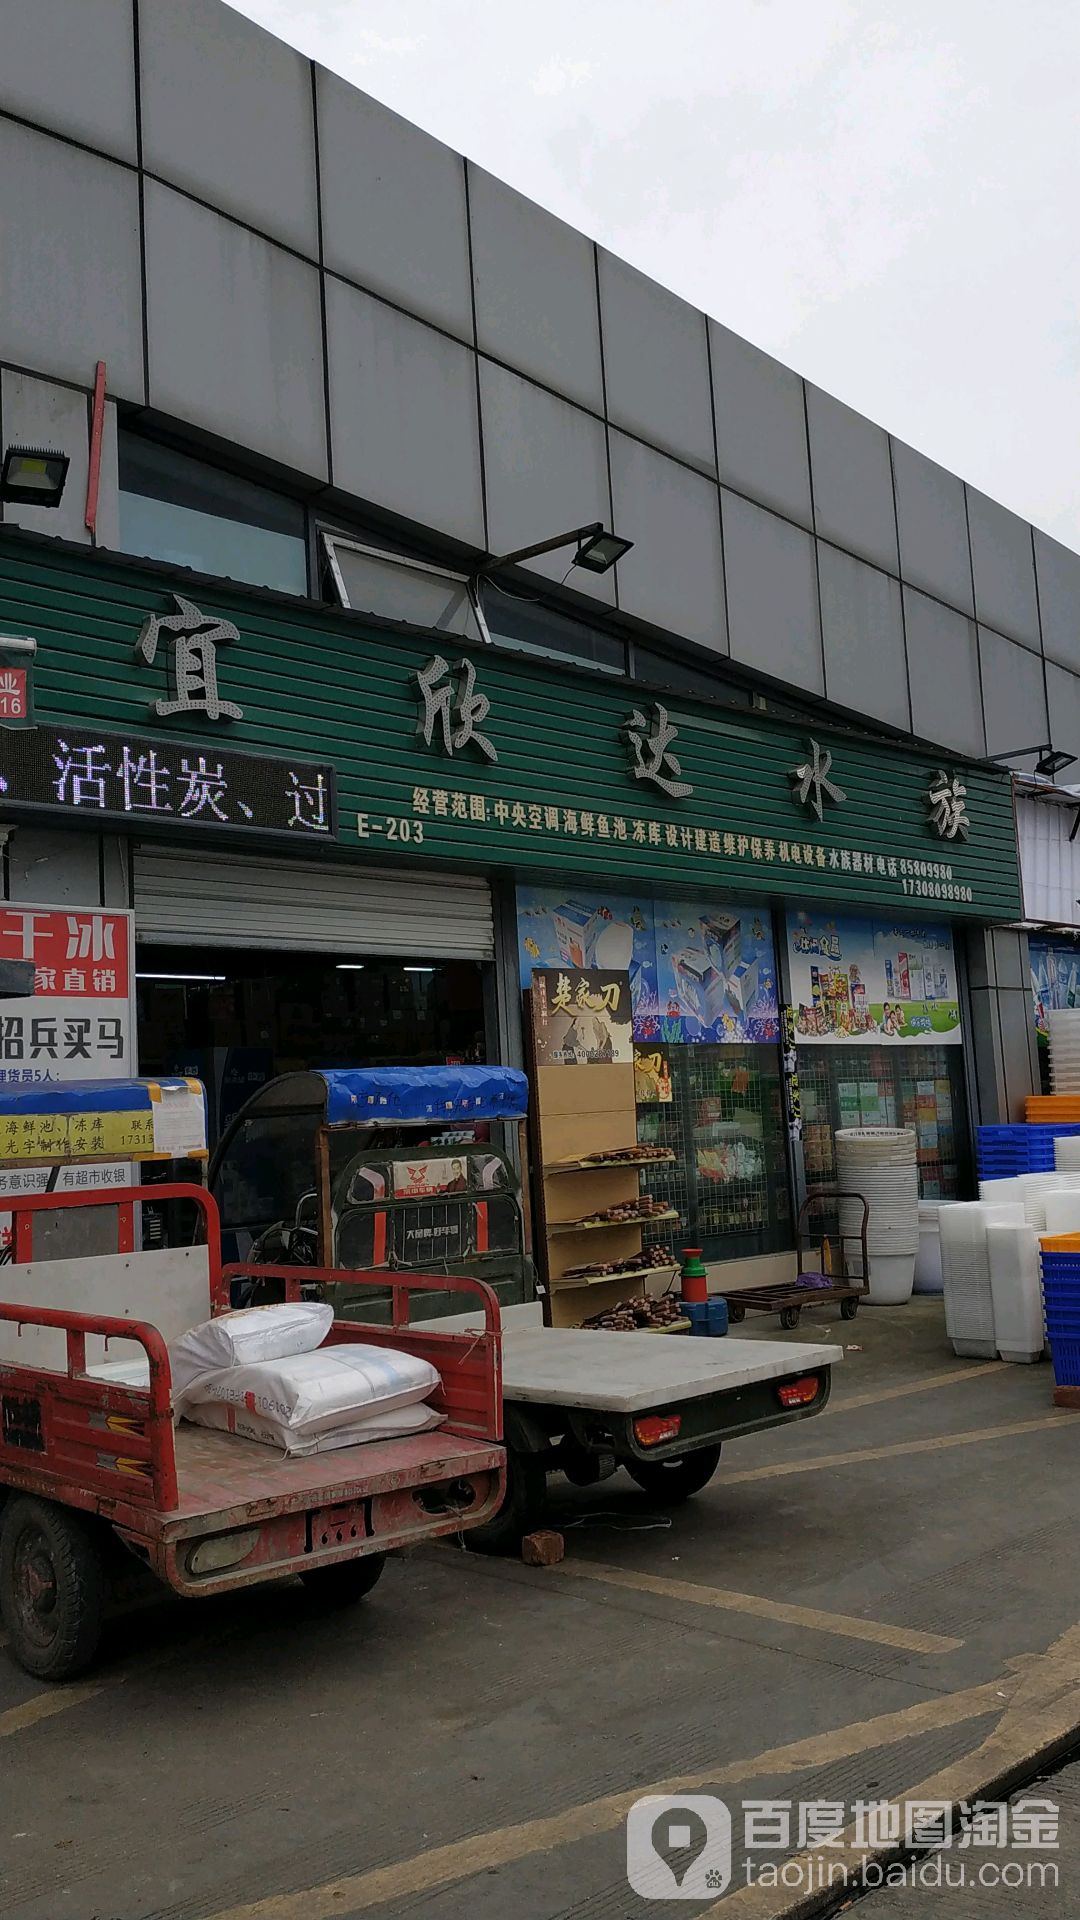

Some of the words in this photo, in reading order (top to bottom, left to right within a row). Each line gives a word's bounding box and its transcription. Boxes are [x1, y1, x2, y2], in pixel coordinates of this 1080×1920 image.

[357, 813, 424, 845] E-203
[3, 911, 115, 961] 干冰
[62, 1168, 126, 1186] 有超市收银
